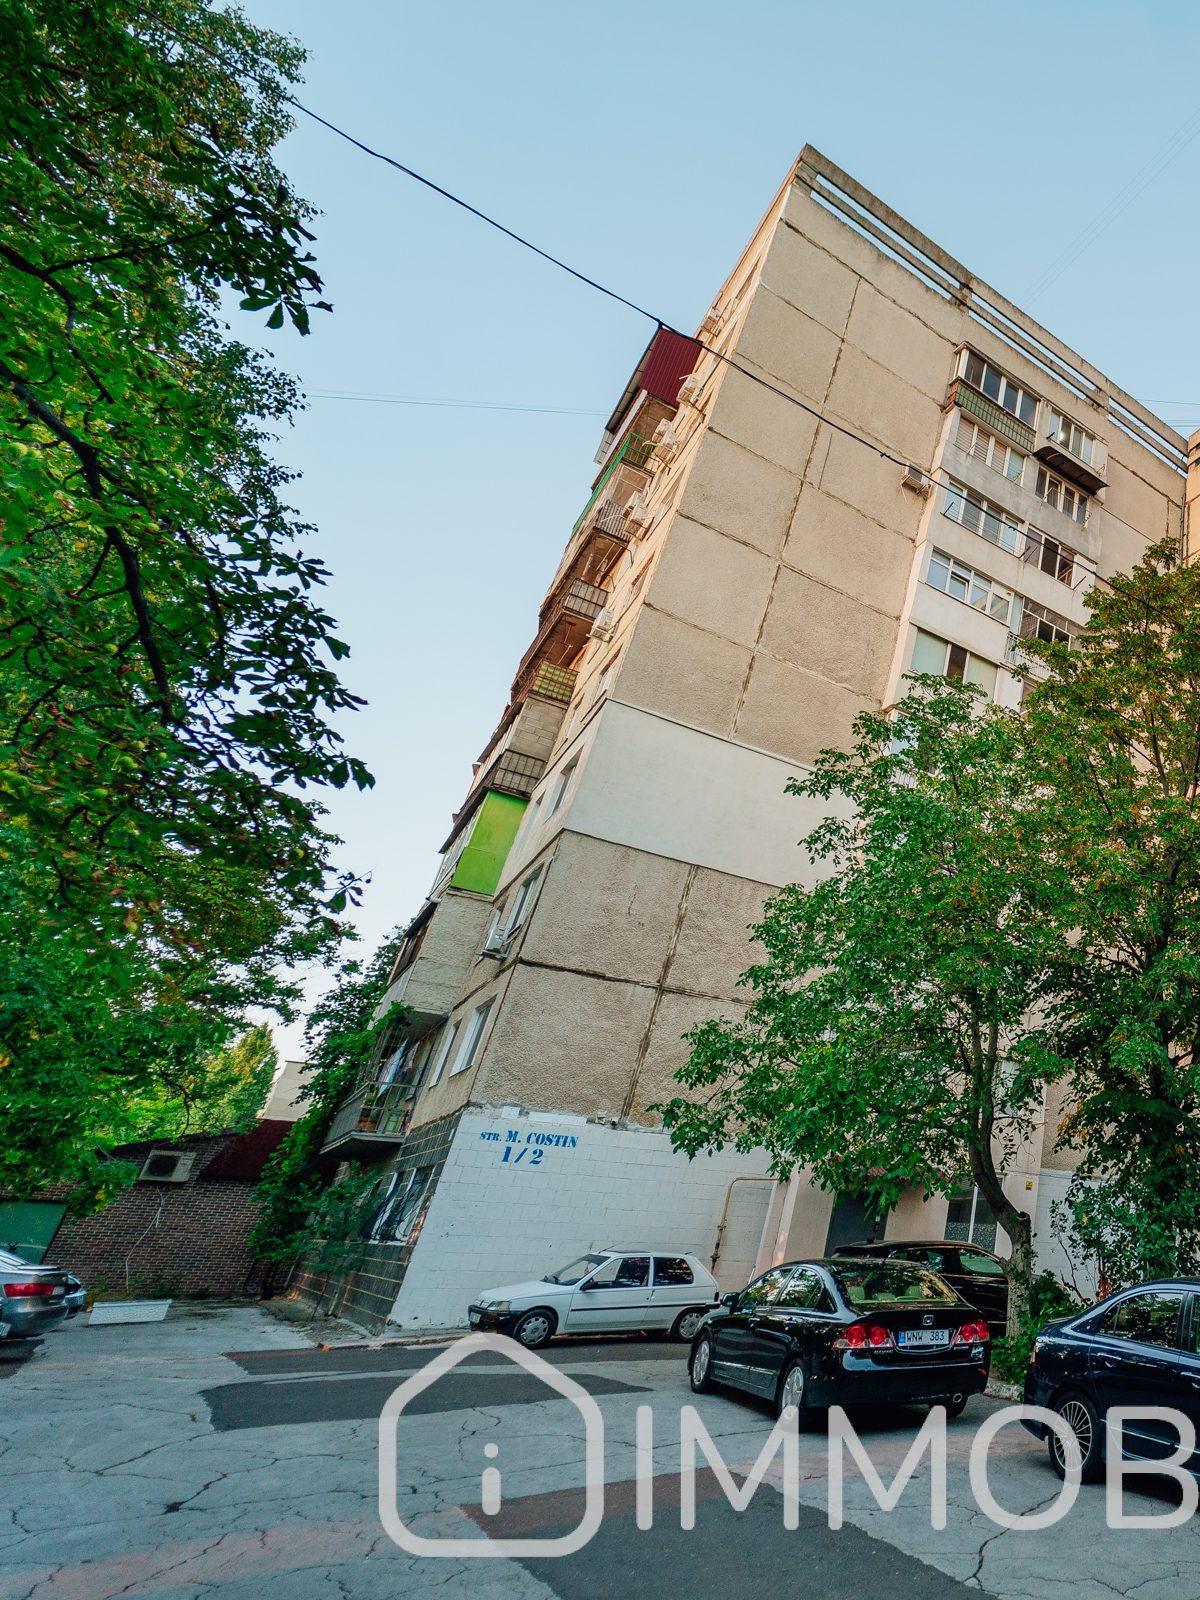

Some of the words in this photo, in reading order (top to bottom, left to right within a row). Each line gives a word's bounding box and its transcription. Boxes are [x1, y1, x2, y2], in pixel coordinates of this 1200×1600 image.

[480, 1131, 502, 1142] STR.
[505, 1130, 521, 1144] M.
[526, 1132, 578, 1148] COSTIN
[501, 1146, 544, 1165] 1/2
[930, 1331, 945, 1341] 383
